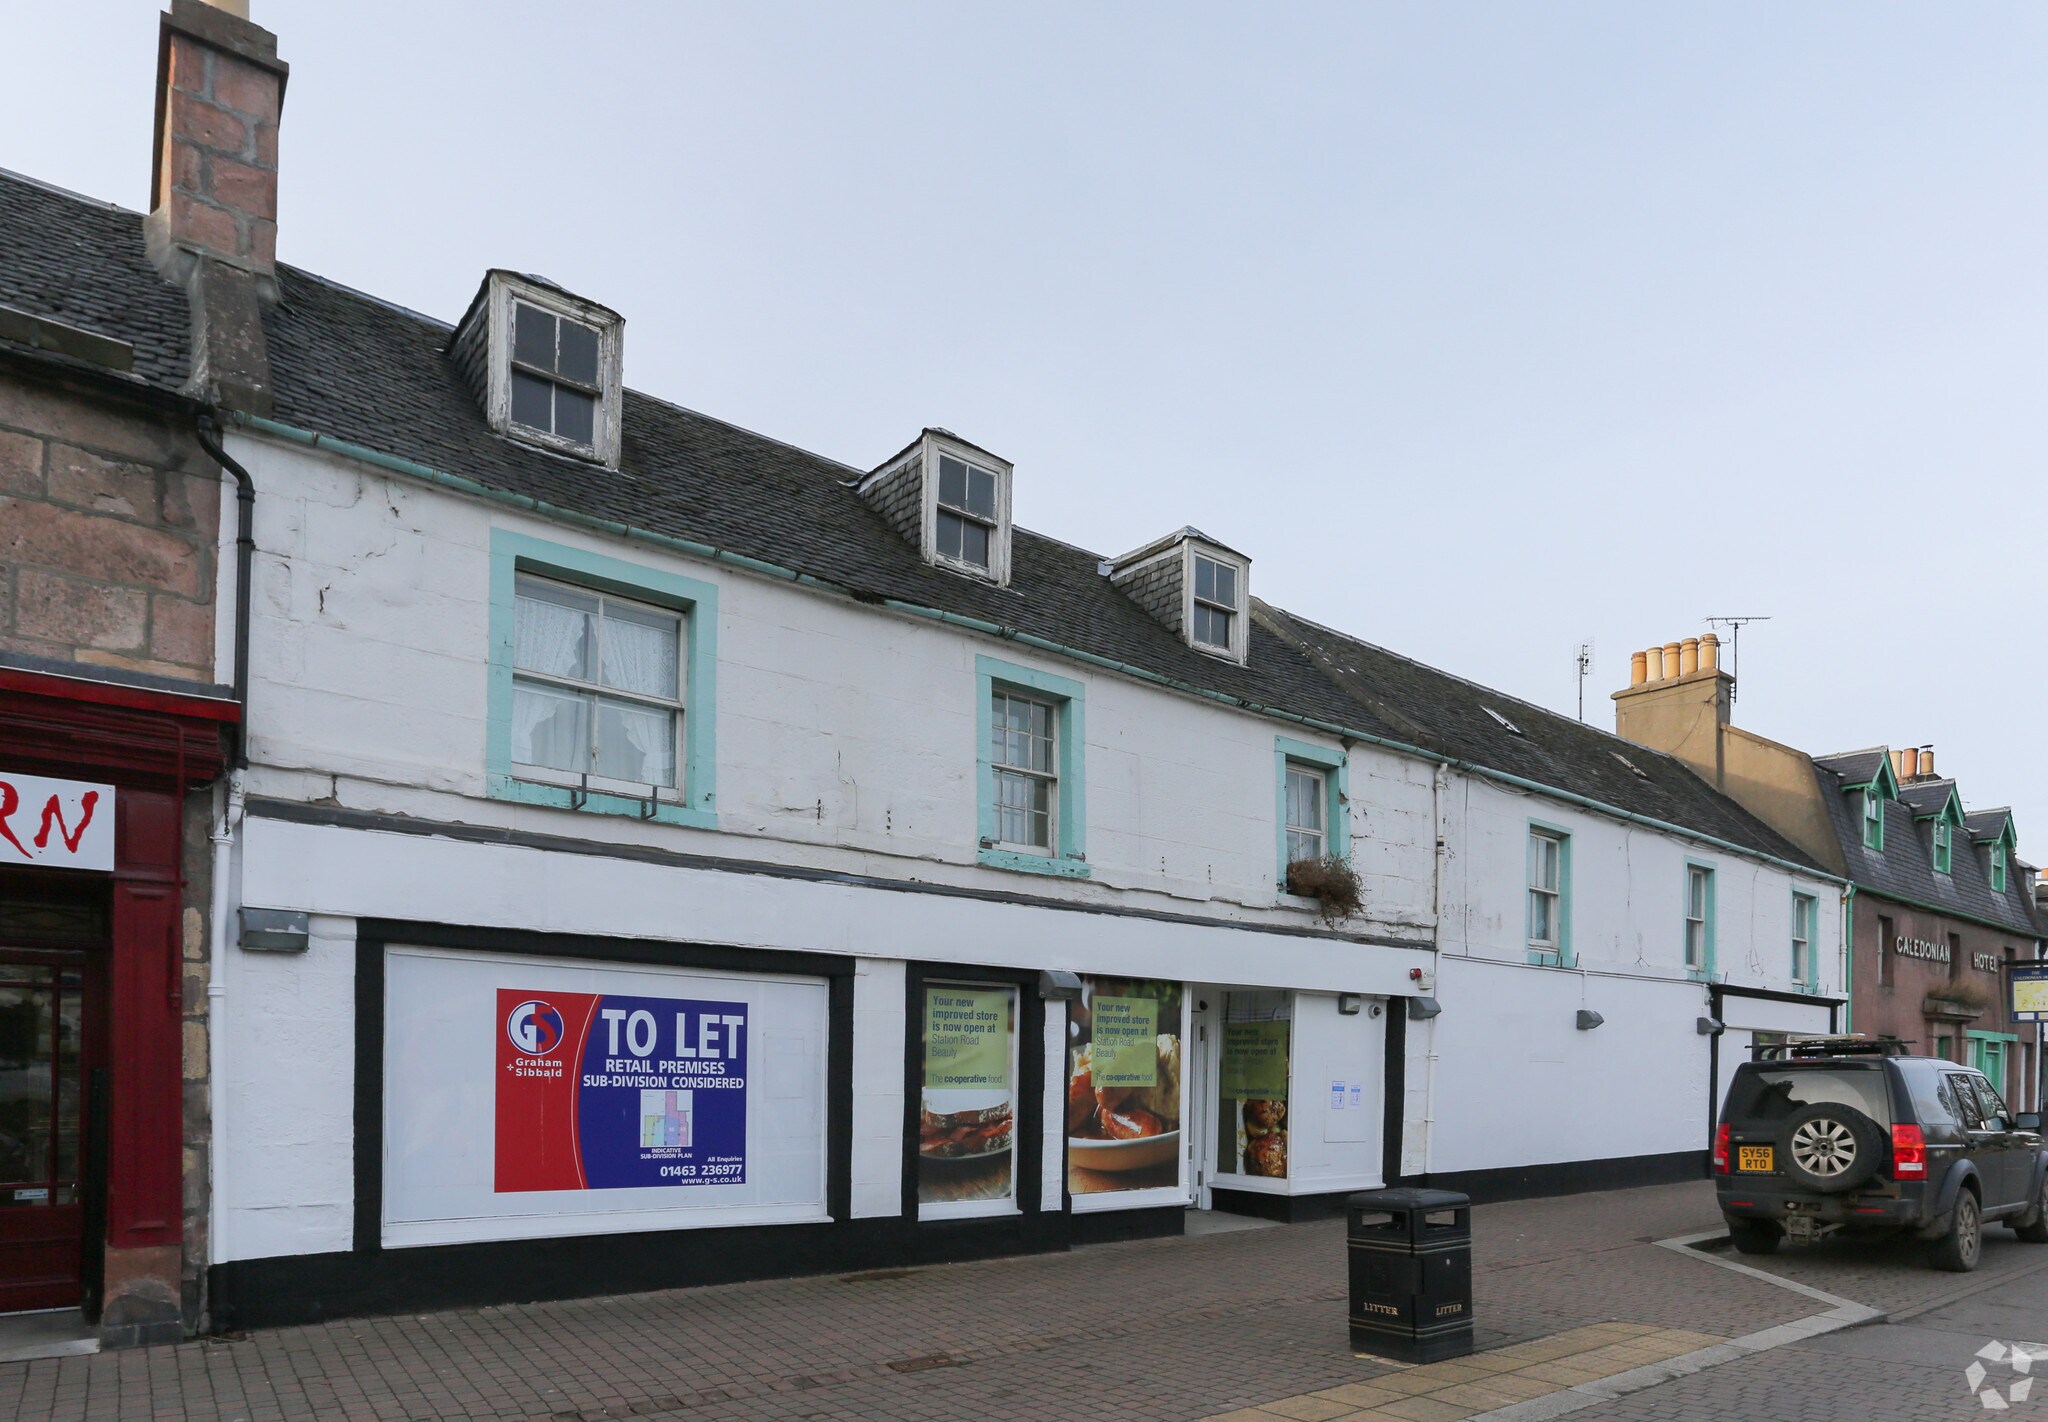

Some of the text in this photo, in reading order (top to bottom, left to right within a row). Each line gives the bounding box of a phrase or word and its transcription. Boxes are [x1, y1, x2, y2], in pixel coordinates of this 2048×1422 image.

[1896, 936, 1998, 972] CALEDONIAN HOTEL
[933, 996, 975, 1007] Your new
[1097, 1002, 1131, 1012] Your new
[933, 1008, 998, 1021] improved store
[1097, 1014, 1150, 1025] improved store
[933, 1021, 996, 1034] is now open at
[1096, 1025, 1148, 1037] is now open at
[602, 1009, 745, 1059] TO LET
[932, 1034, 980, 1045] Station Road
[1096, 1037, 1135, 1047] Station Road
[932, 1047, 957, 1059] Beauly
[1096, 1049, 1116, 1059] Beauly
[516, 1057, 562, 1067] Graham
[606, 1059, 726, 1075] RETAIL PREMISES
[516, 1068, 562, 1077] Sibbald
[1106, 1073, 1141, 1082] co-operative
[583, 1075, 744, 1089] SUB-DIVISION CONSIDERED
[932, 1074, 1002, 1084] The co-operative food
[1741, 1148, 1770, 1158] SY56
[1745, 1159, 1767, 1169] RTO
[660, 1164, 743, 1177] 01463 236977
[681, 1176, 742, 1185] www.g-s.co.uk
[1363, 1302, 1398, 1316] LITTER
[1435, 1303, 1462, 1316] LITTER
